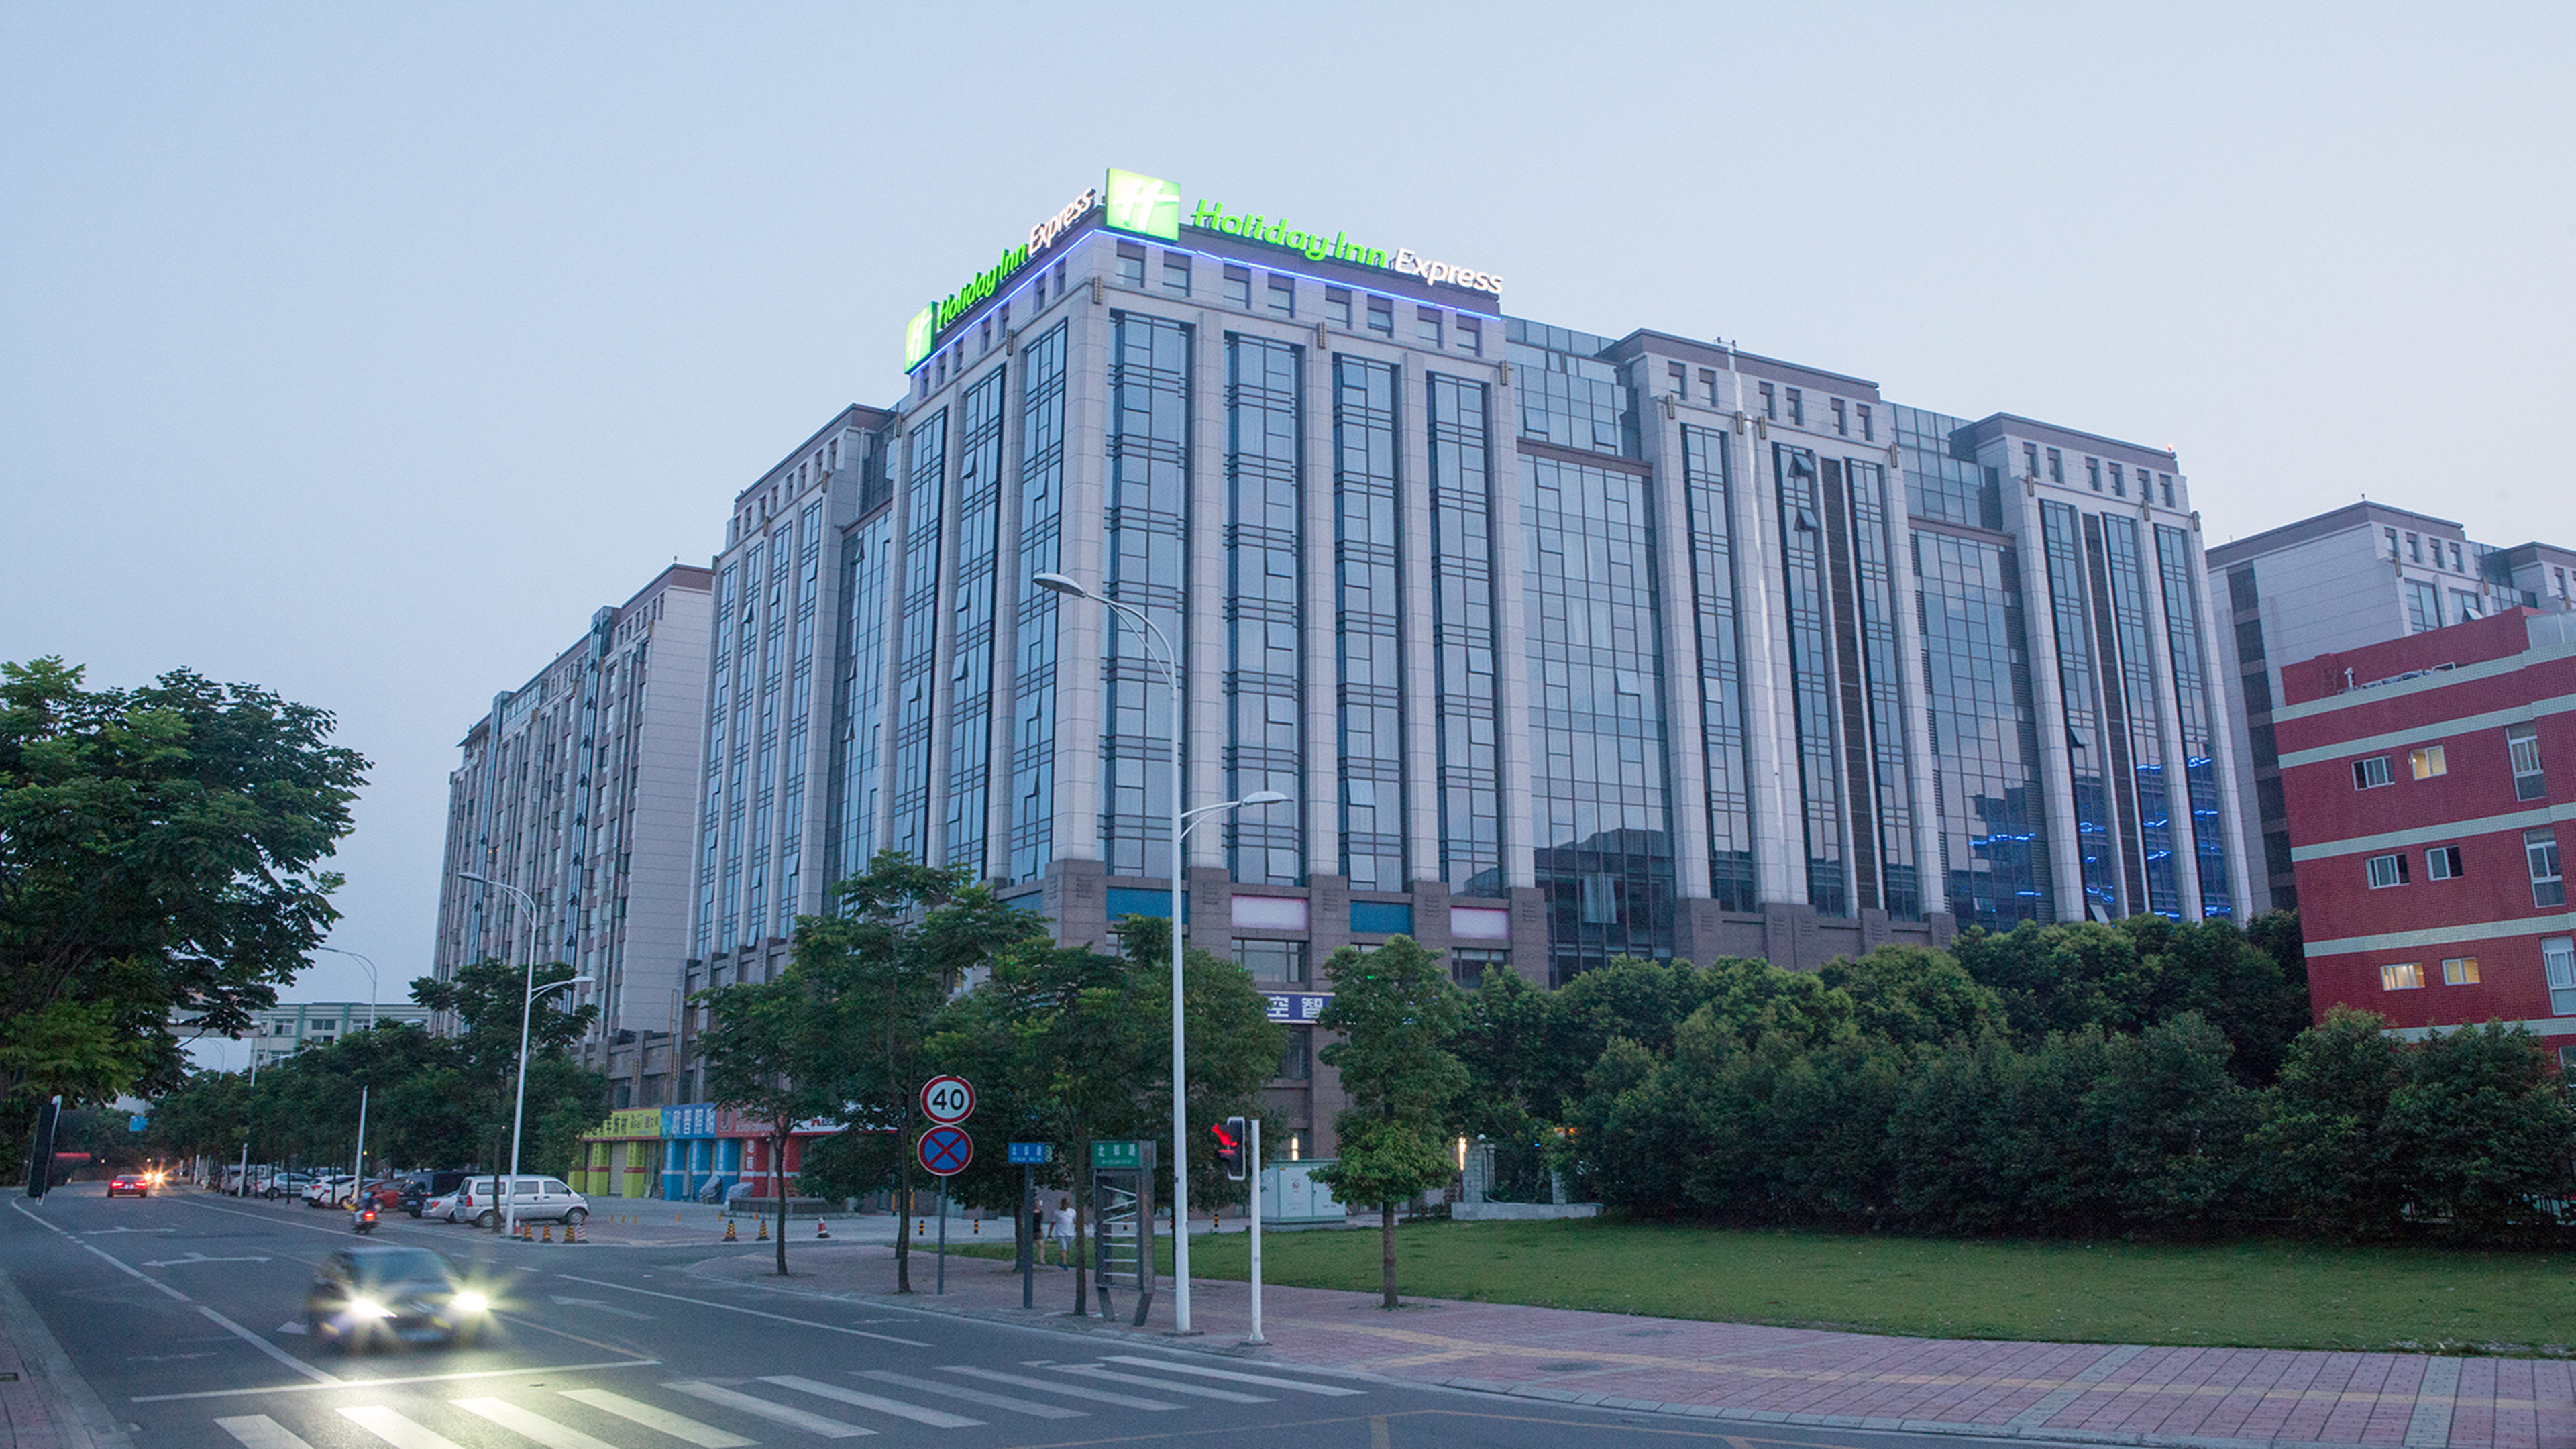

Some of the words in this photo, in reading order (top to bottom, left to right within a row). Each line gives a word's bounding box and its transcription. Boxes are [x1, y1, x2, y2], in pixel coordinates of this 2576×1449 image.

[938, 265, 999, 328] Holiday
[999, 243, 1028, 280] Inn
[1028, 186, 1096, 256] Express
[1191, 198, 1330, 262] Holiday
[1334, 231, 1387, 268] Inn
[1394, 247, 1504, 294] Express
[1267, 996, 1323, 1018] 空智
[932, 1088, 965, 1111] 40
